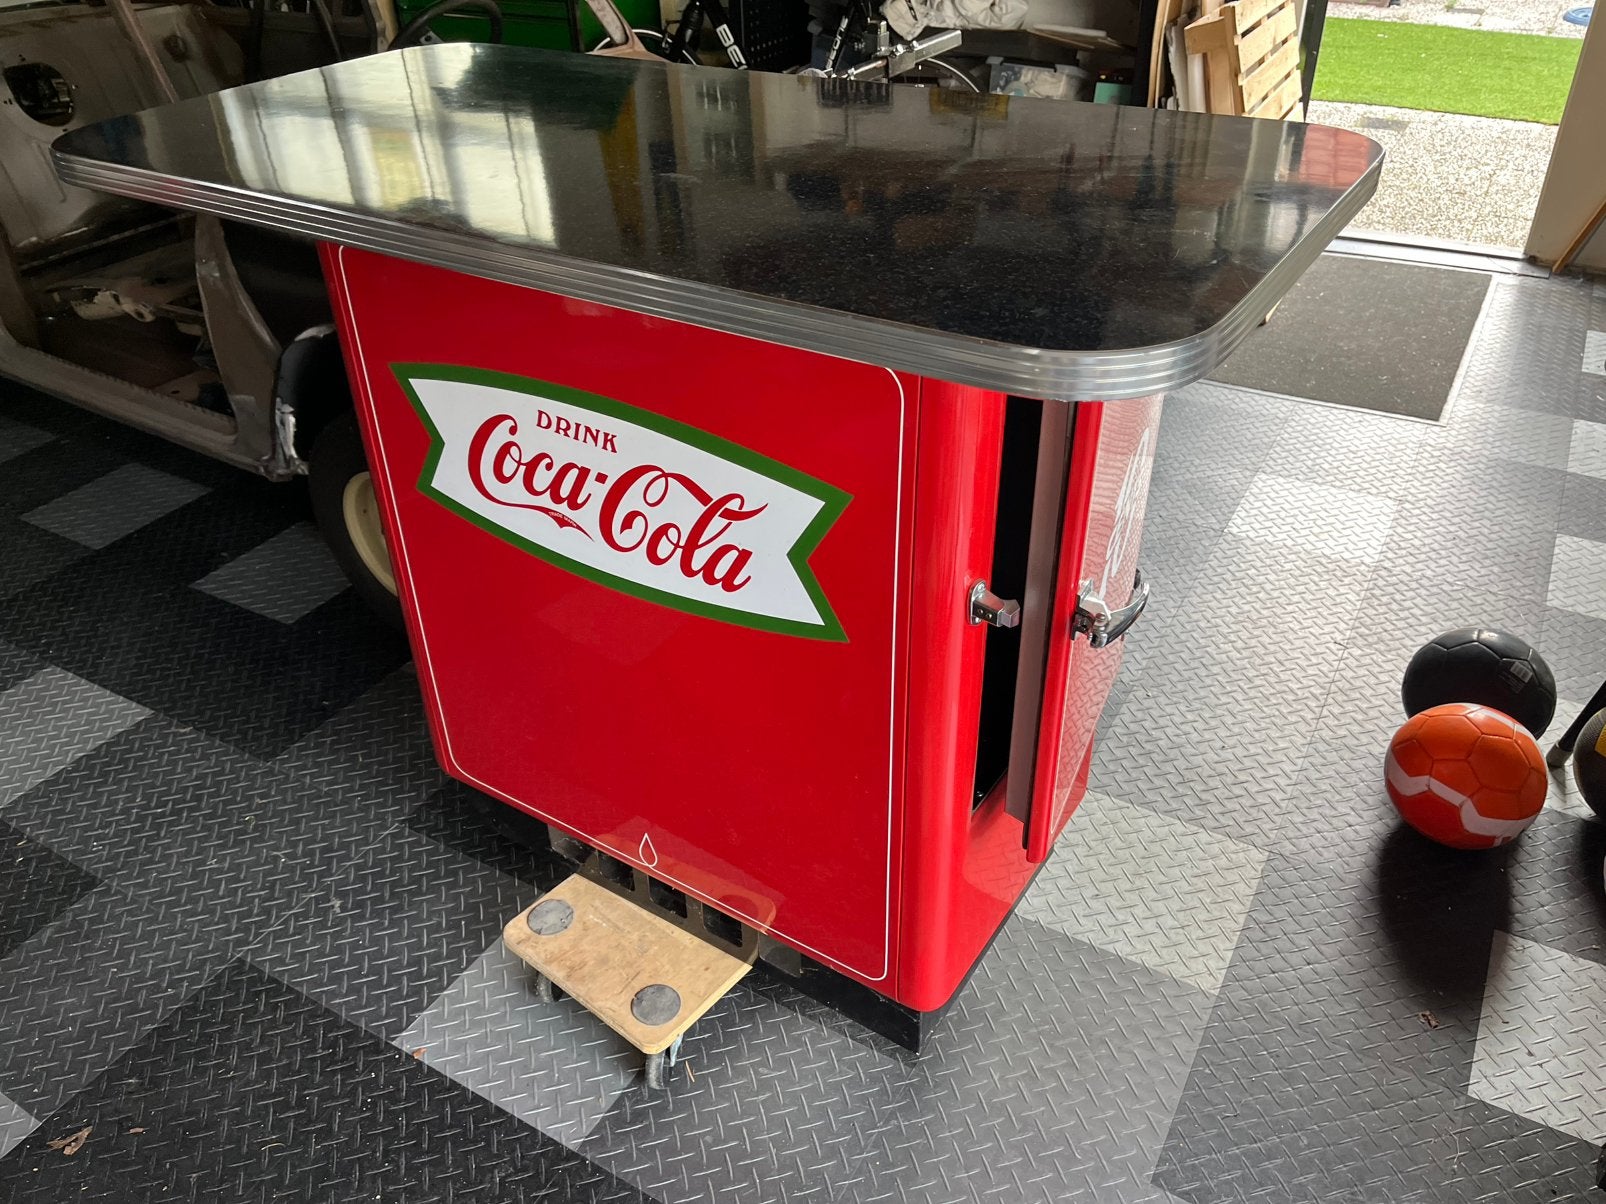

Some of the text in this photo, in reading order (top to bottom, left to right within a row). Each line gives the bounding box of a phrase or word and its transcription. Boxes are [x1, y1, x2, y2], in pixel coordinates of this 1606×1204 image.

[715, 23, 748, 70] BE
[536, 409, 618, 453] DRINK
[468, 414, 768, 592] Coca-Cola
